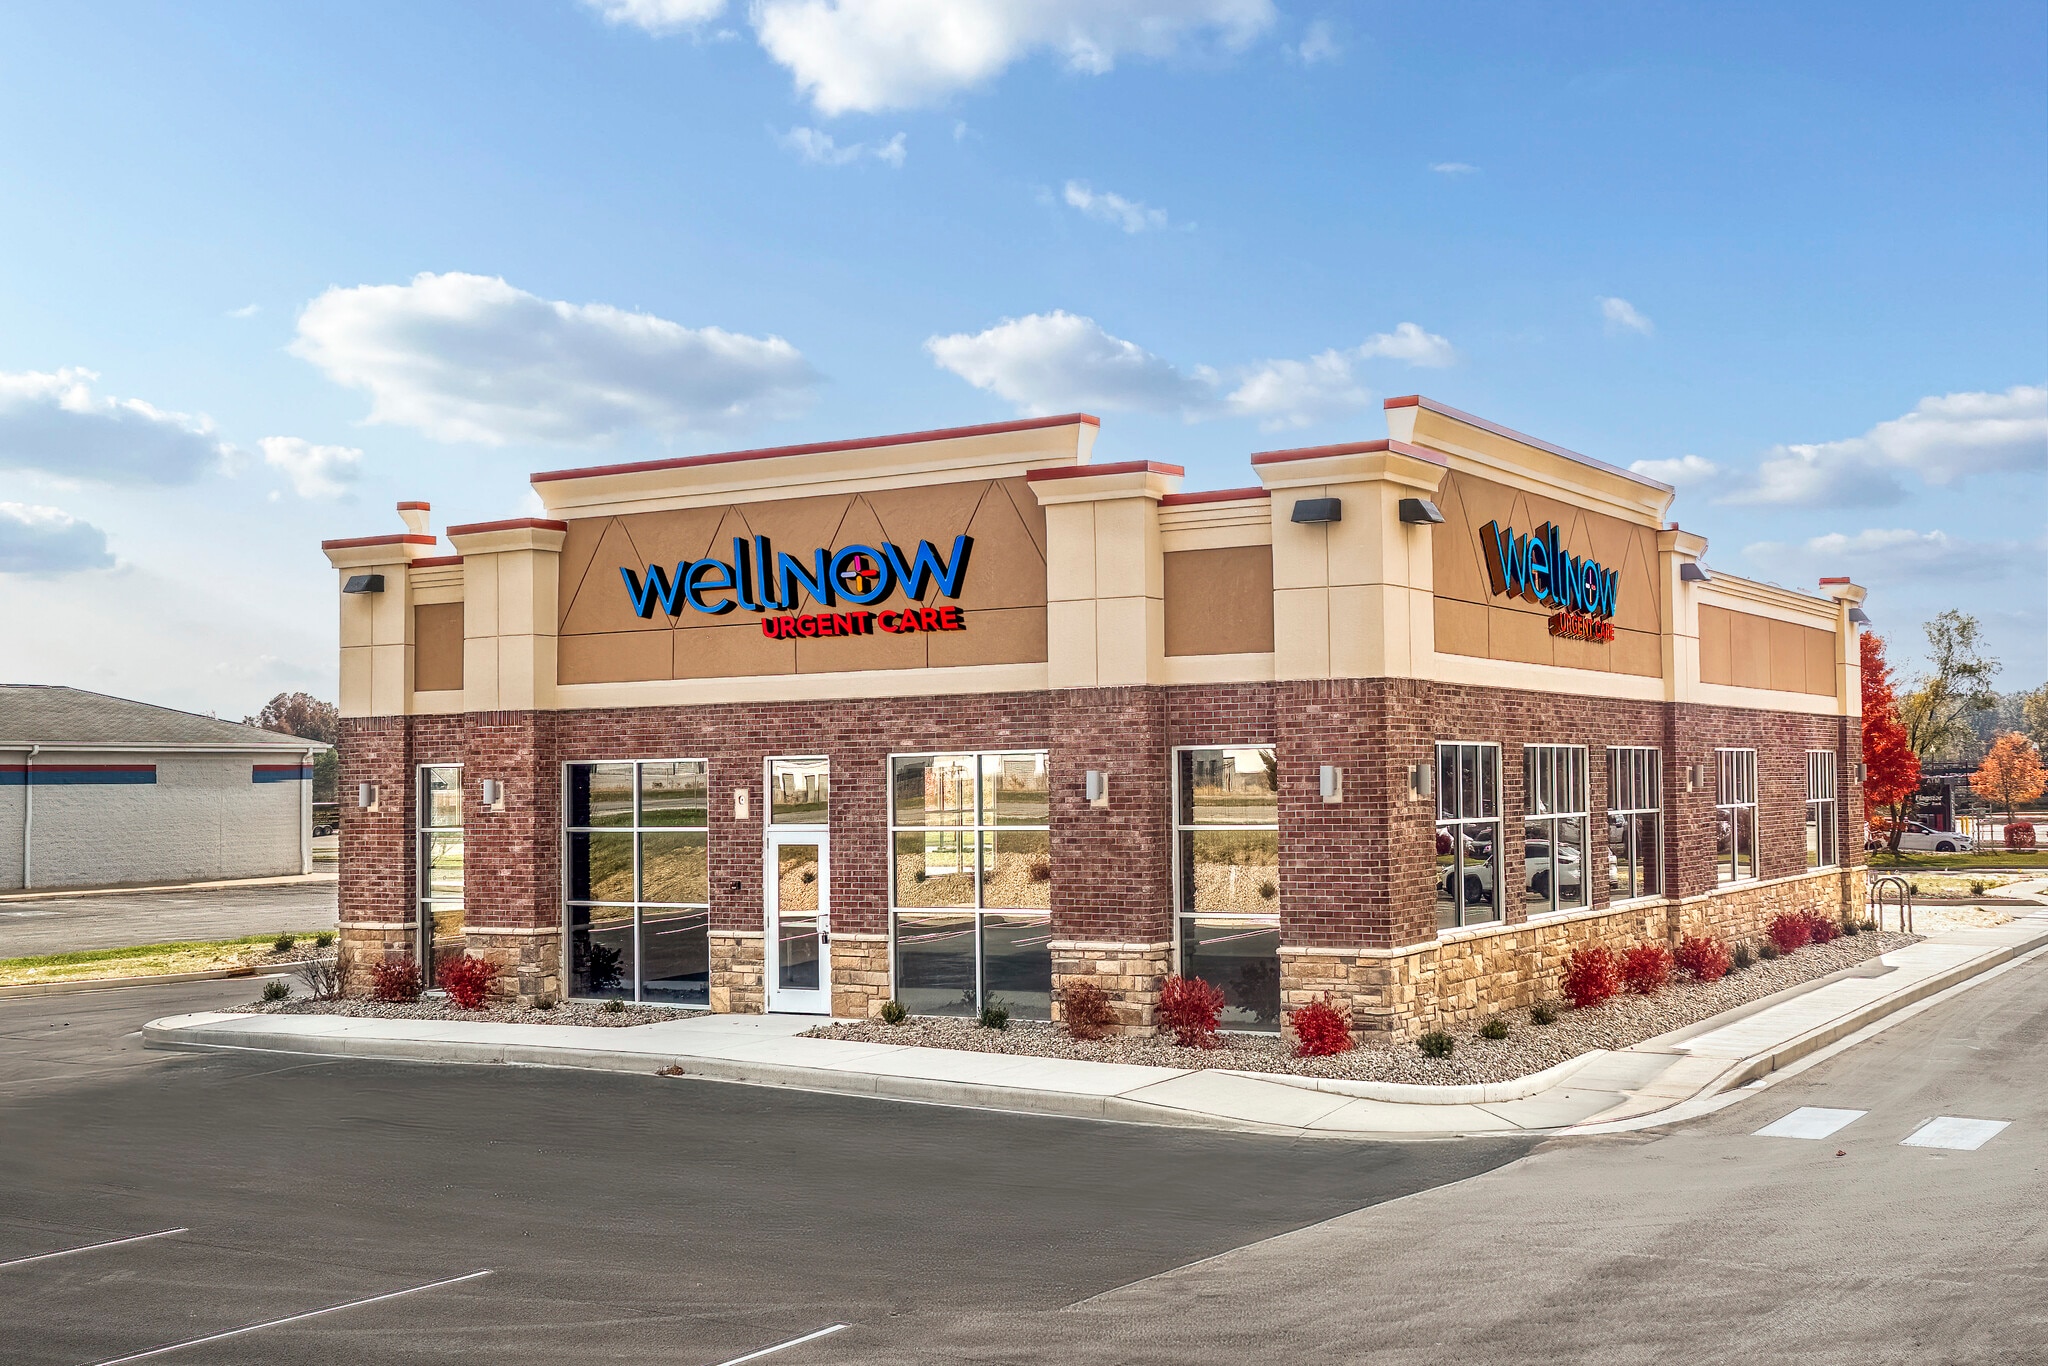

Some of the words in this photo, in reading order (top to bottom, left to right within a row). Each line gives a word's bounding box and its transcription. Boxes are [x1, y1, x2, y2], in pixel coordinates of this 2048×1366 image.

[761, 611, 873, 639] URGENT
[877, 606, 964, 633] CARE
[1559, 612, 1593, 637] URGENT
[1595, 620, 1614, 640] CARE
